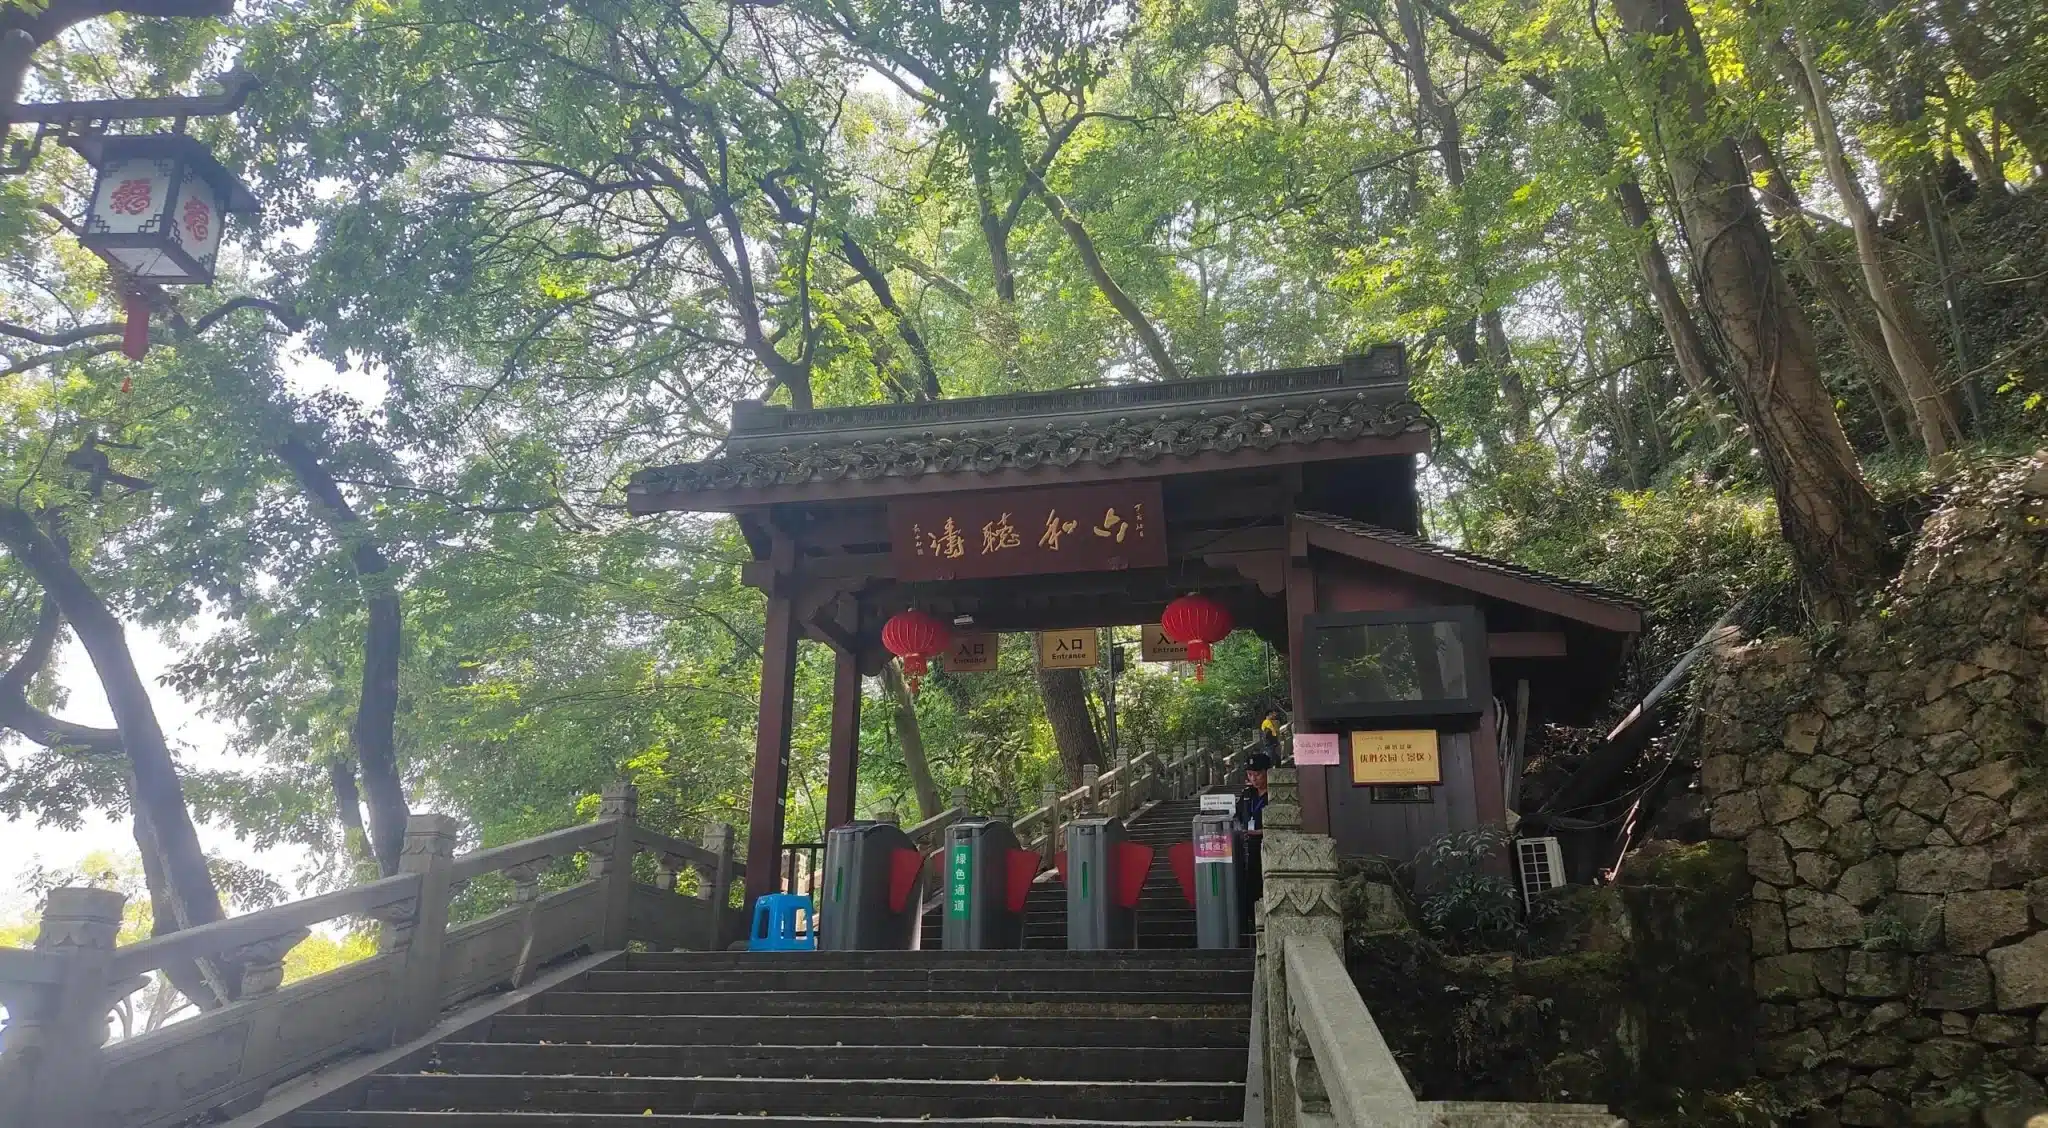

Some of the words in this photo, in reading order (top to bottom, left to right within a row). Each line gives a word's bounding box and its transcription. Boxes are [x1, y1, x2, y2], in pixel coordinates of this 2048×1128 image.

[958, 644, 984, 655] 入口
[1056, 639, 1083, 651] 入口
[954, 853, 966, 912] 绿色通道
